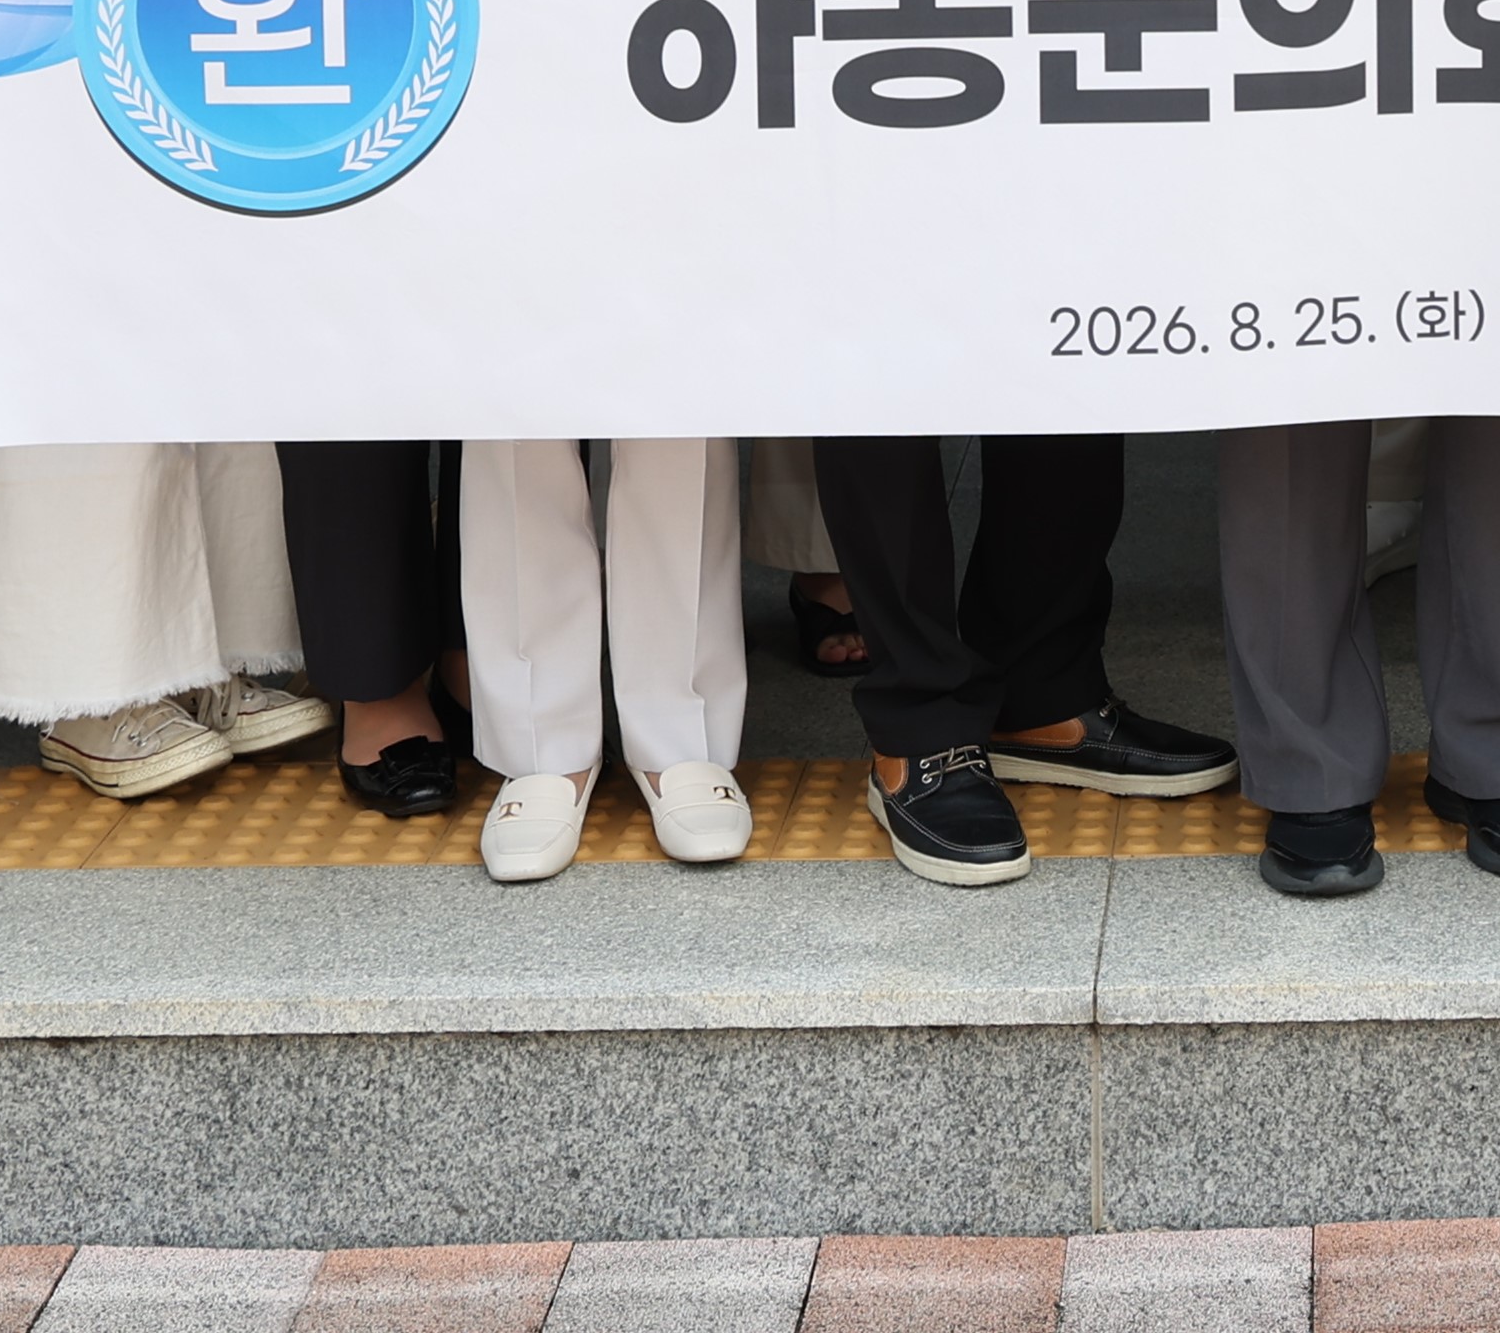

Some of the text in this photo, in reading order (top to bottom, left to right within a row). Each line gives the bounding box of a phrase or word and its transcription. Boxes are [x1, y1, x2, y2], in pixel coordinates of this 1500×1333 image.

[1050, 289, 1485, 356] 2026. 8. 25. (화)
